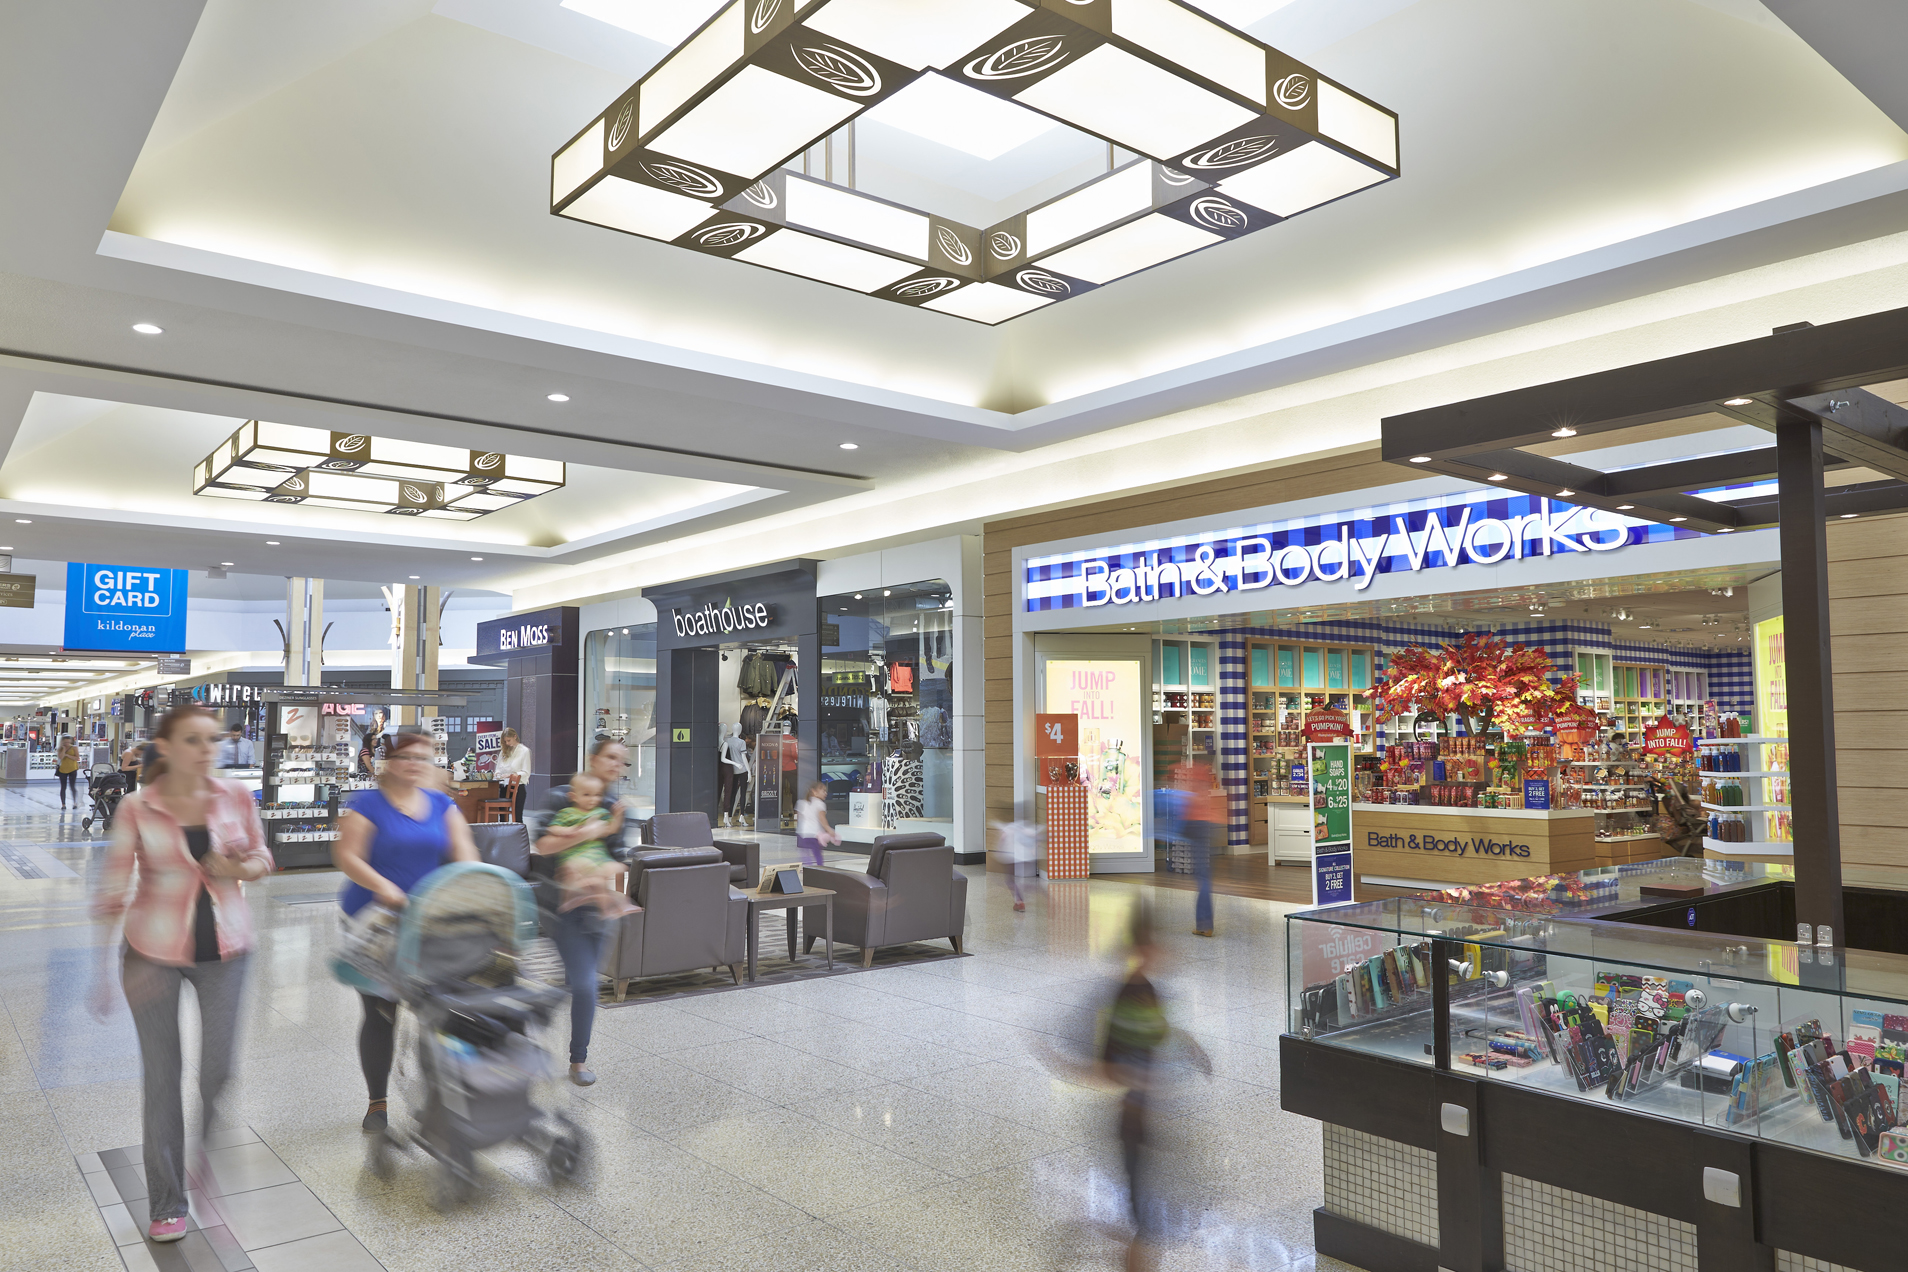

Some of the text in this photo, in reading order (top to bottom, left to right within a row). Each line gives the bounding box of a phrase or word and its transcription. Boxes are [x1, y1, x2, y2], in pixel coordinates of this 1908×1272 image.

[1081, 496, 1628, 608] Bath & Body Works
[94, 570, 161, 592] GIFT
[93, 590, 160, 608] CARD
[672, 601, 768, 637] boathouse
[97, 620, 156, 632] kildonan
[129, 629, 156, 640] place
[500, 624, 549, 650] BEN MOSS
[1070, 671, 1116, 691] JUMP
[1083, 691, 1100, 699] INTO
[1070, 700, 1114, 720] FALL!
[1311, 722, 1344, 731] PUMPKIN!
[1045, 722, 1064, 744] $4
[1656, 729, 1676, 737] JUMP
[478, 738, 501, 750] SALE
[1647, 738, 1687, 749] INTO FALL!
[1330, 760, 1343, 768] HAND
[1329, 768, 1345, 776] SOAPS
[1327, 779, 1333, 791] 4
[1336, 779, 1347, 791] $20
[1328, 796, 1334, 808] 6
[1336, 796, 1348, 808] $25
[1367, 831, 1531, 858] Bath & Body Works
[1325, 879, 1344, 890] 2 FREE
